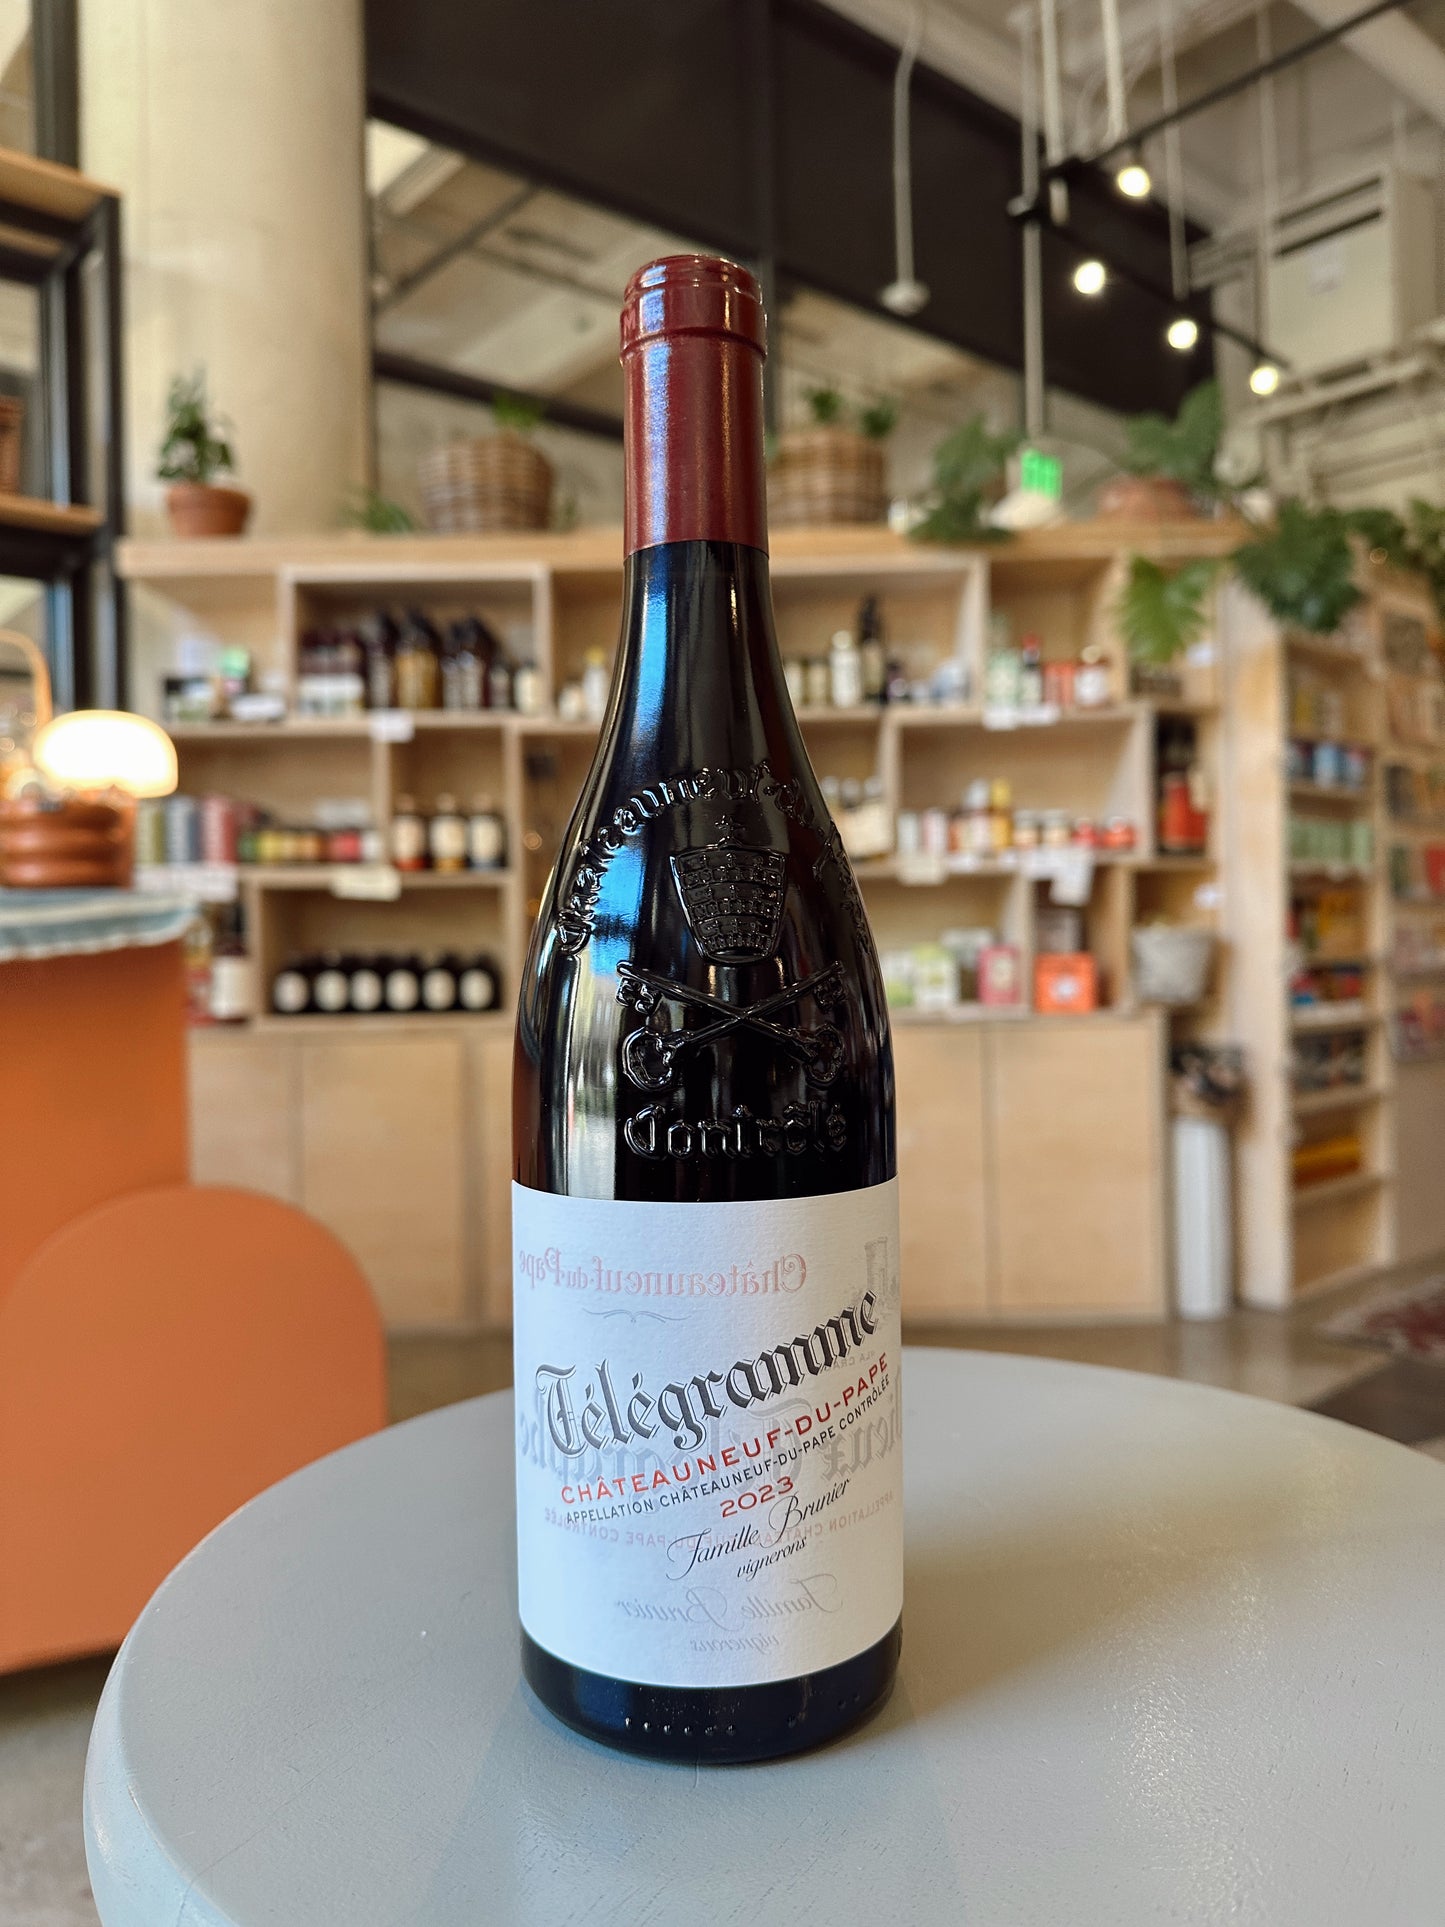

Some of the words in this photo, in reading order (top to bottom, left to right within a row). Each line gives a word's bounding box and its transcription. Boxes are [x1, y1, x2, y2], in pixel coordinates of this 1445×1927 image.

[535, 1289, 880, 1460] Télégramme
[560, 1352, 888, 1504] CHÂTEAUNEUF-DU-PAPE
[566, 1498, 654, 1525] APPELLATION
[659, 1425, 836, 1507] CHÂTEAUNEUF-DU-PAPE
[838, 1373, 890, 1431] CONTRÔLÉE
[719, 1475, 794, 1518] 2023
[665, 1523, 760, 1581] Famille
[759, 1477, 852, 1549] Brunier
[736, 1535, 808, 1582] vignerons
